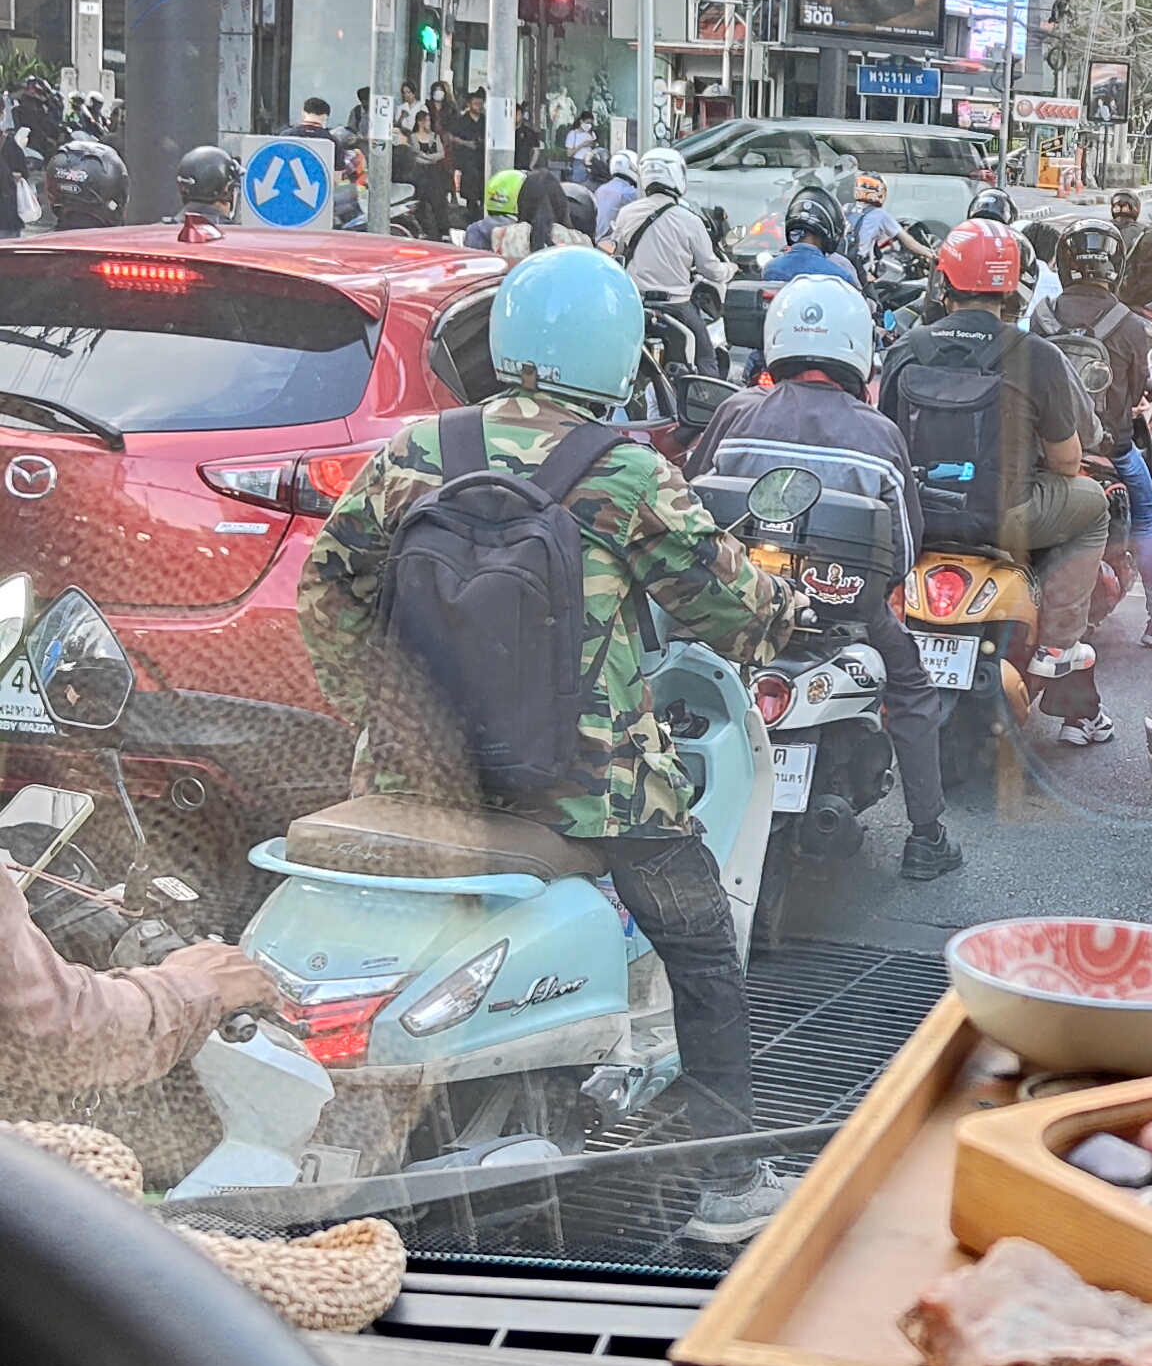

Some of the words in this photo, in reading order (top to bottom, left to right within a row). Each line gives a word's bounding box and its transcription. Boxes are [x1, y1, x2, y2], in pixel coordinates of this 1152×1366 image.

[803, 9, 834, 26] 300
[868, 71, 911, 85] พระราม
[374, 97, 391, 118] 12
[956, 330, 986, 341] Security
[18, 721, 57, 735] MAZDA
